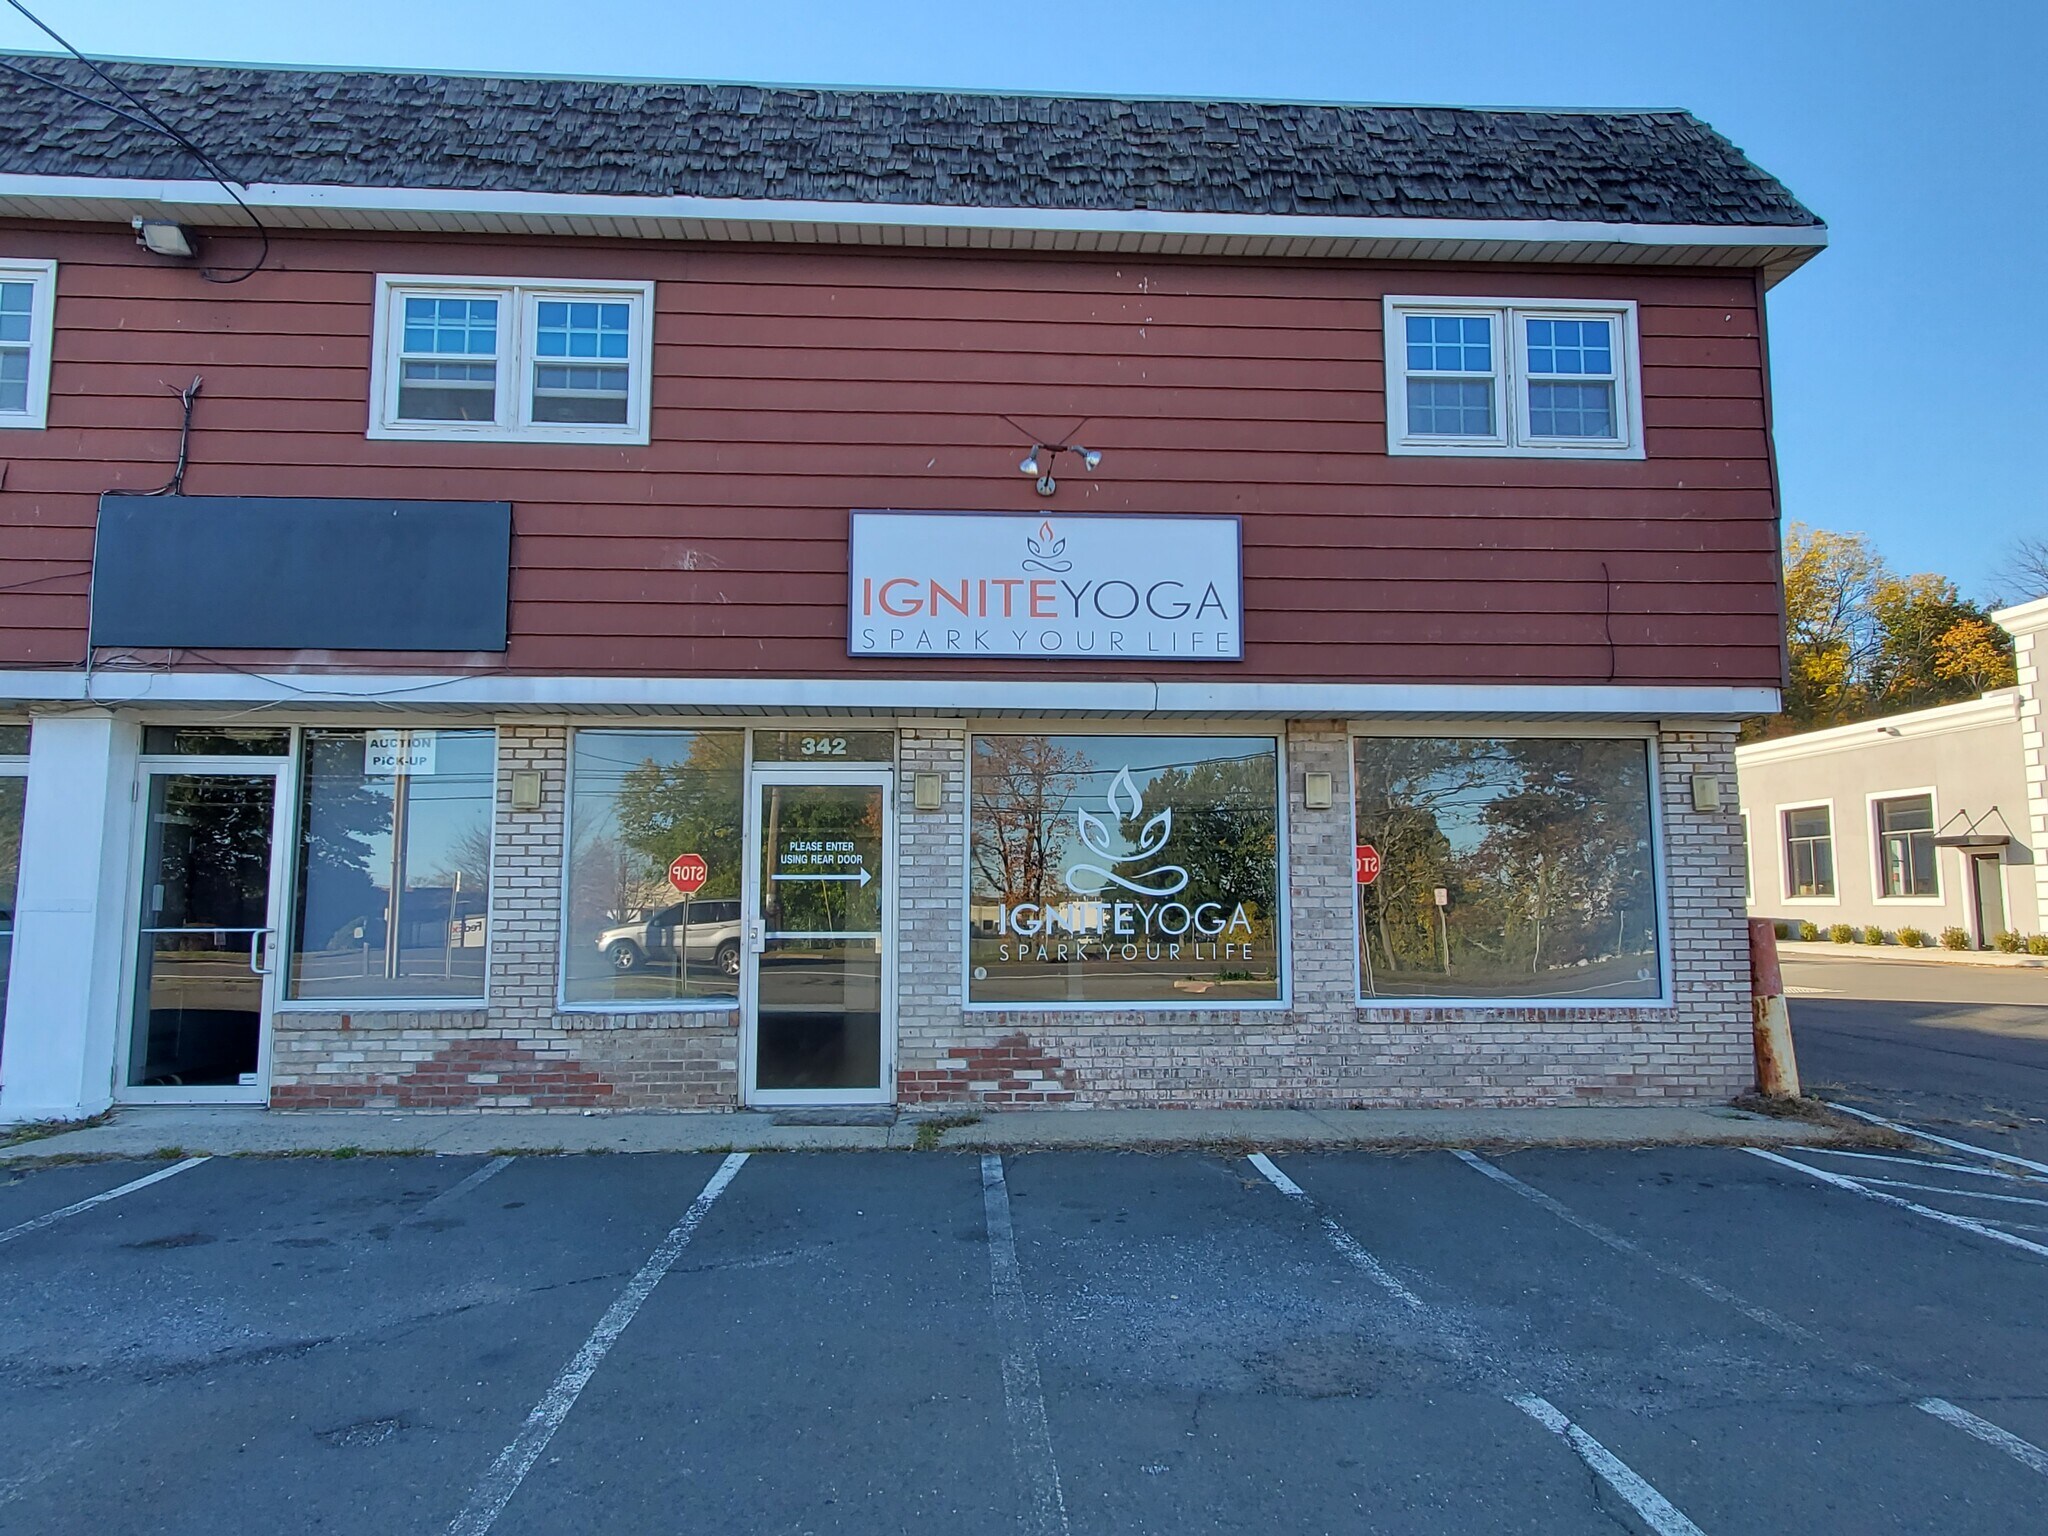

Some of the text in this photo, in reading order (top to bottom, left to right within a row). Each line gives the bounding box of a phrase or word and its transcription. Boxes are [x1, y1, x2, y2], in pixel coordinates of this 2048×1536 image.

[863, 577, 1229, 620] IGNITEYOGA
[862, 628, 1230, 653] SPARK YOUR LIFE
[370, 738, 431, 748] AUCTION
[801, 737, 847, 755] 342
[789, 841, 854, 852] PLEASE ENTER
[780, 854, 863, 865] USING REAR DOOR
[998, 902, 1253, 936] IGNITEYOGA
[999, 943, 1253, 961] SPARK YOUR LIFE
